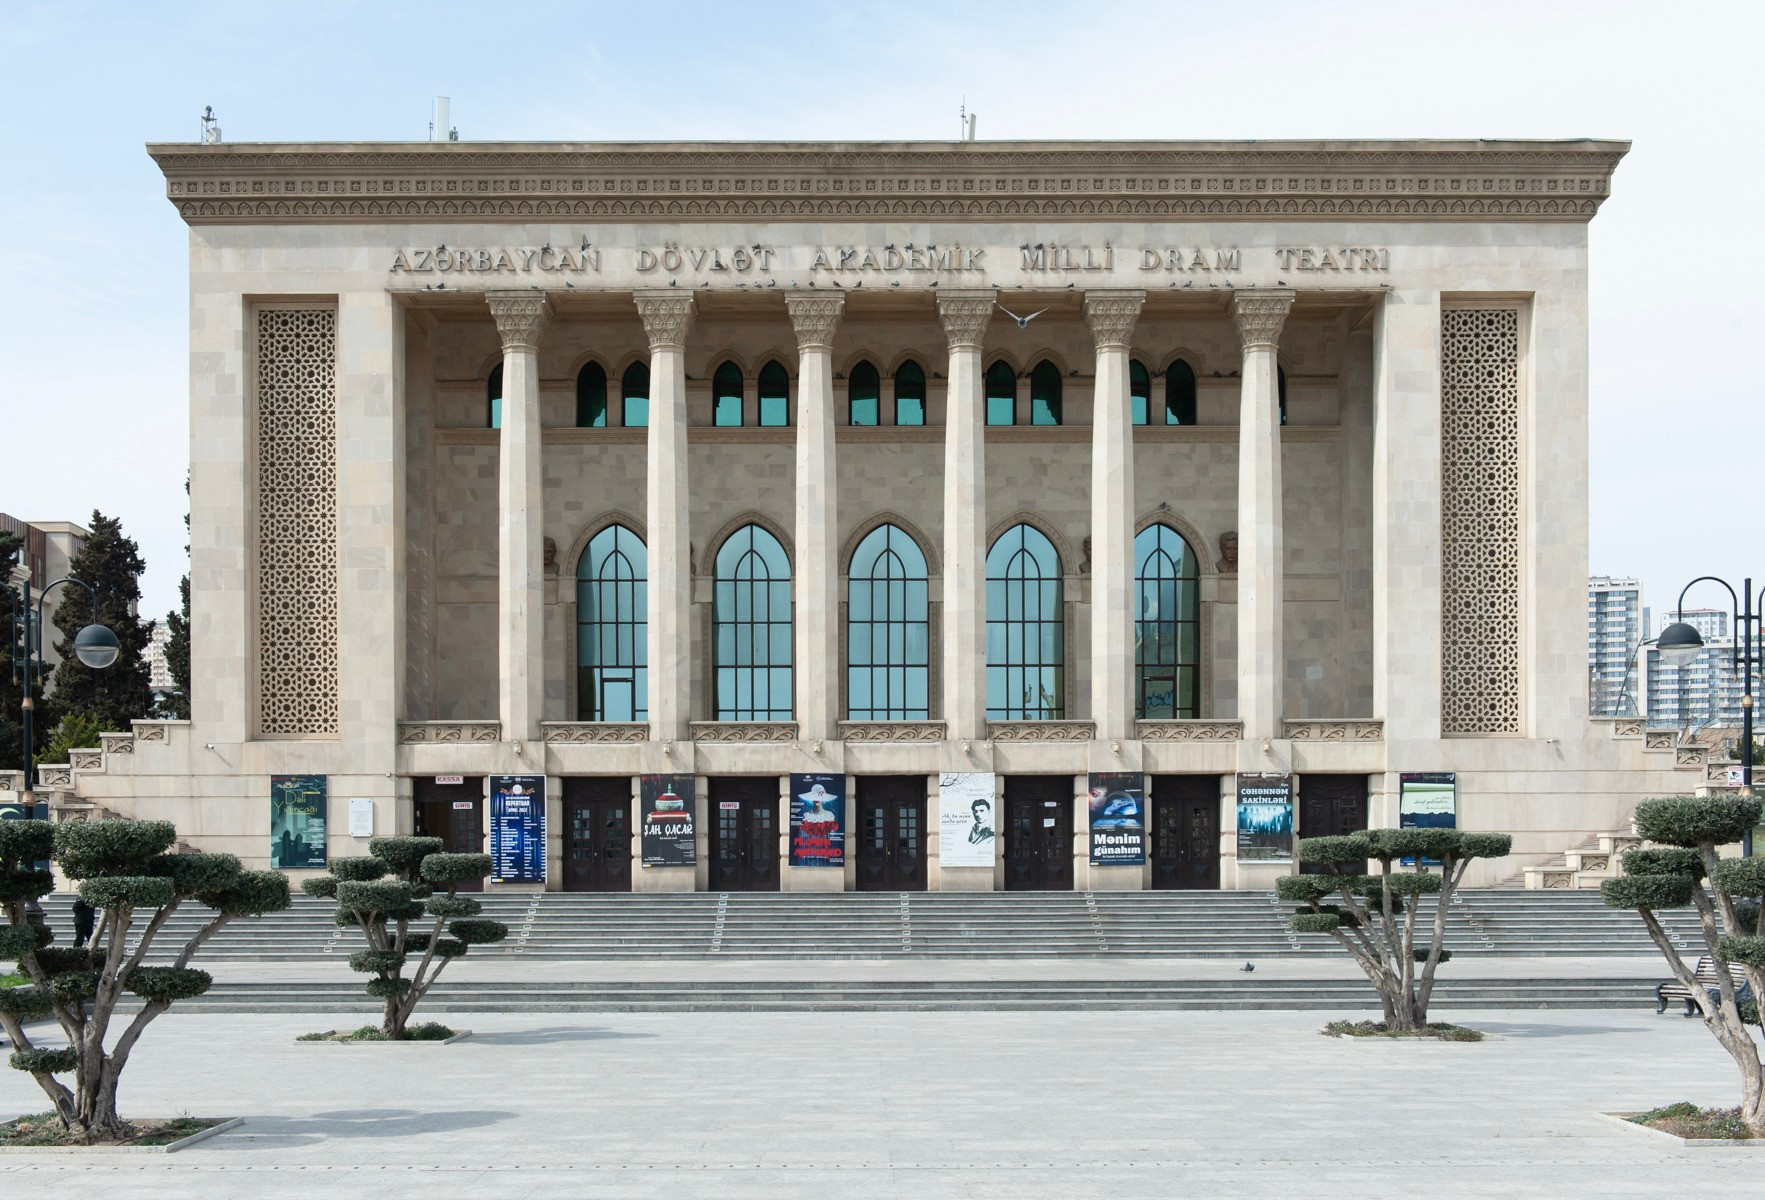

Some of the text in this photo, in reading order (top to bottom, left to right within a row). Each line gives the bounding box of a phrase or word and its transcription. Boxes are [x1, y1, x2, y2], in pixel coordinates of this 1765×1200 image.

[389, 241, 1389, 272] AZƏRBAYCAN DÖVLƏT AKADEMİK MİLLİ DRAM TEATRI
[1242, 796, 1287, 804] SAKİNLƏRİ
[665, 823, 693, 837] QACAR
[1094, 833, 1140, 845] Mənim
[1093, 845, 1141, 857] günahım
